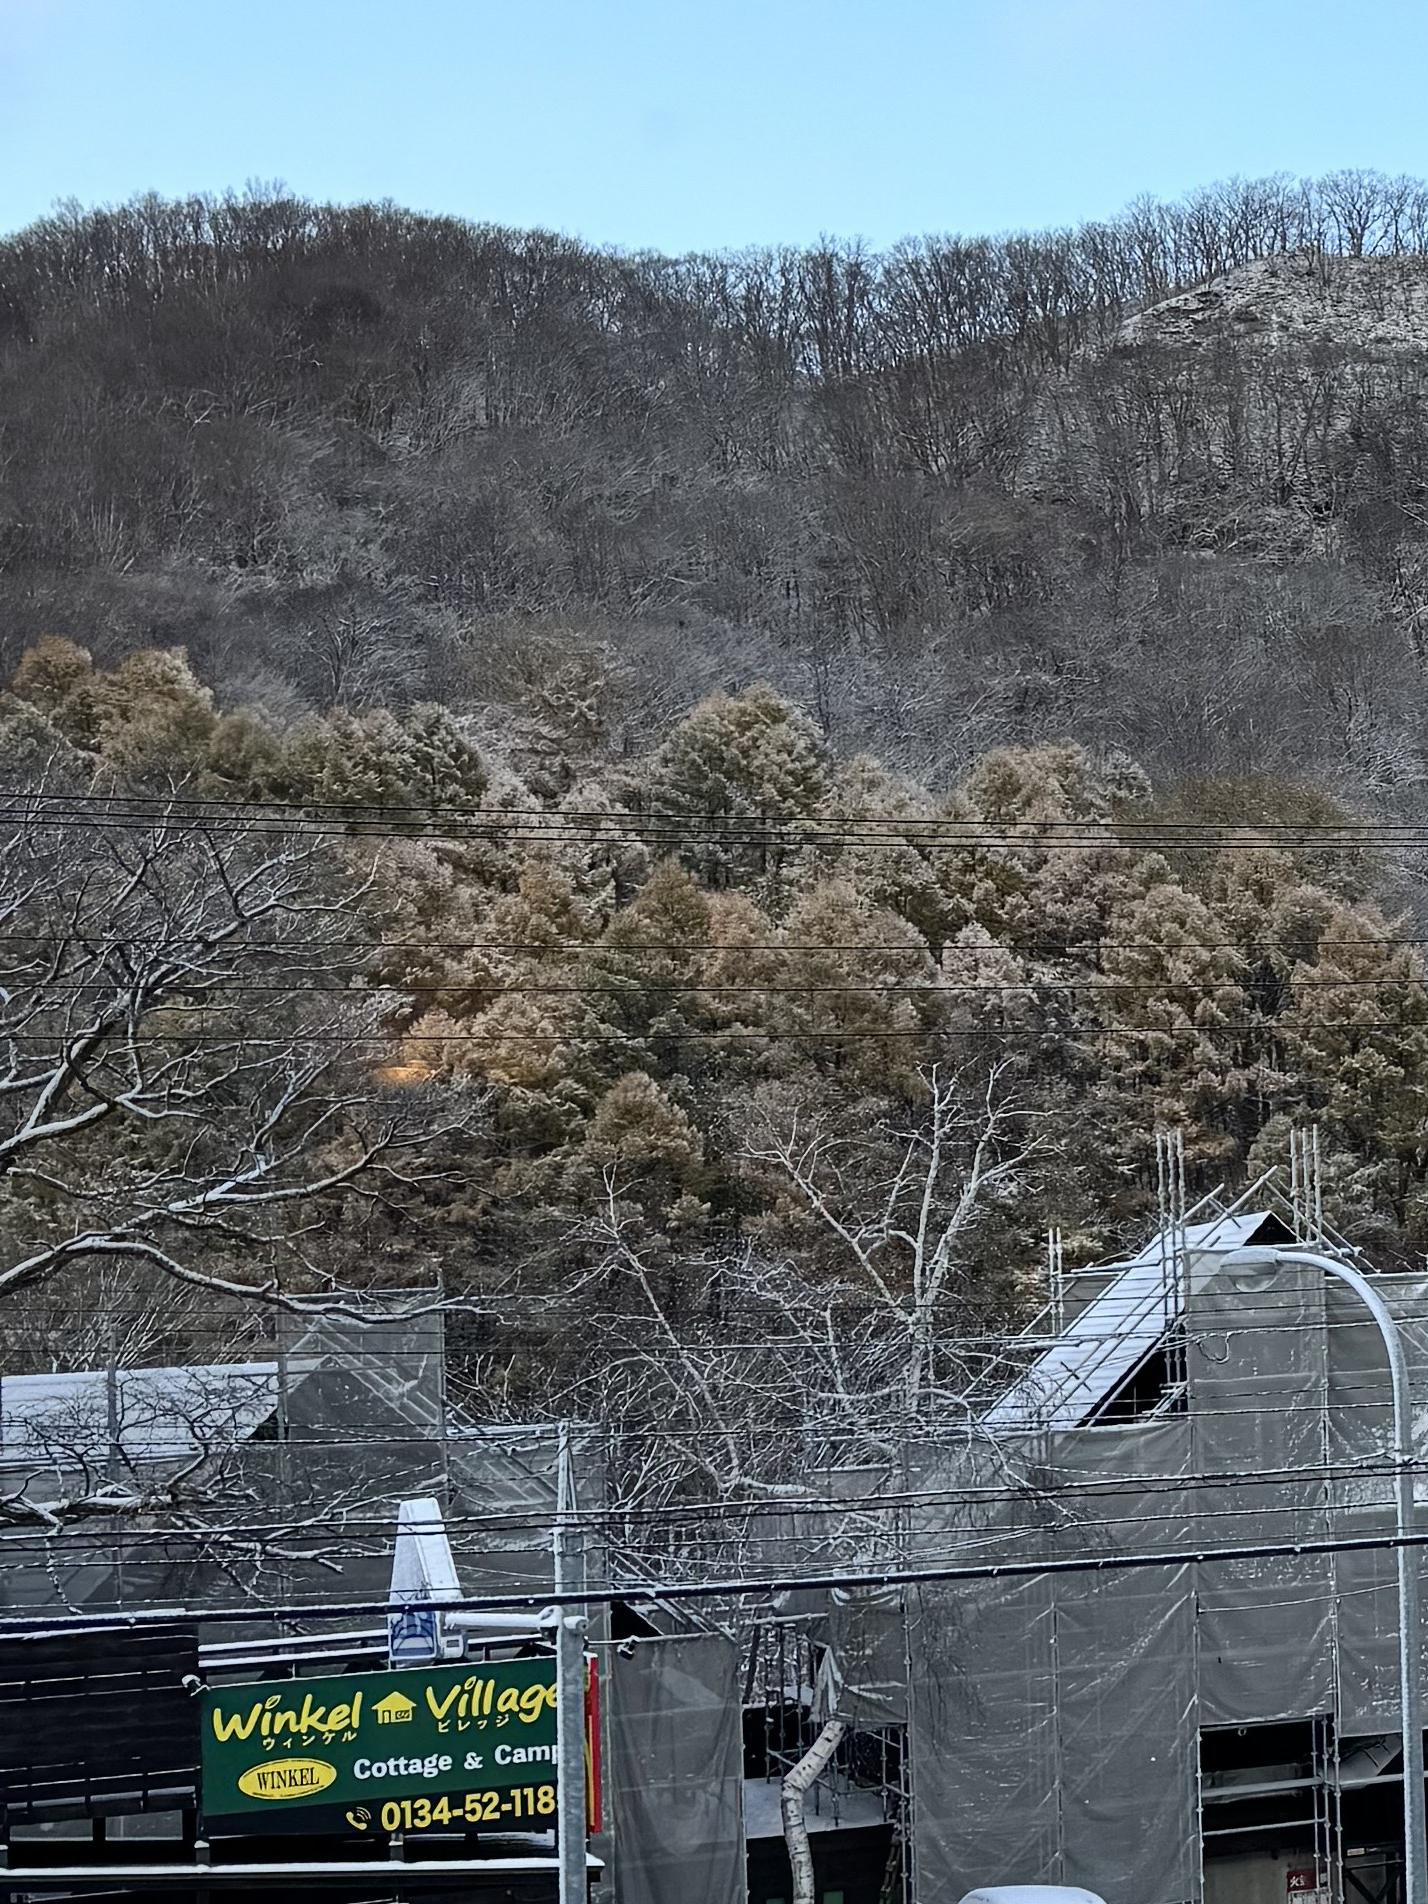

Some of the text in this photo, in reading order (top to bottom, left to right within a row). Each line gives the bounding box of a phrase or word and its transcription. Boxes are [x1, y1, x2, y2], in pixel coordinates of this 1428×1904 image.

[213, 1691, 364, 1743] Winkel
[262, 1730, 357, 1752] ウィンケル
[257, 1766, 320, 1792] WINKEL
[353, 1753, 453, 1780] Cottage
[463, 1751, 484, 1770] &
[381, 1784, 557, 1832] 0134-52-118
